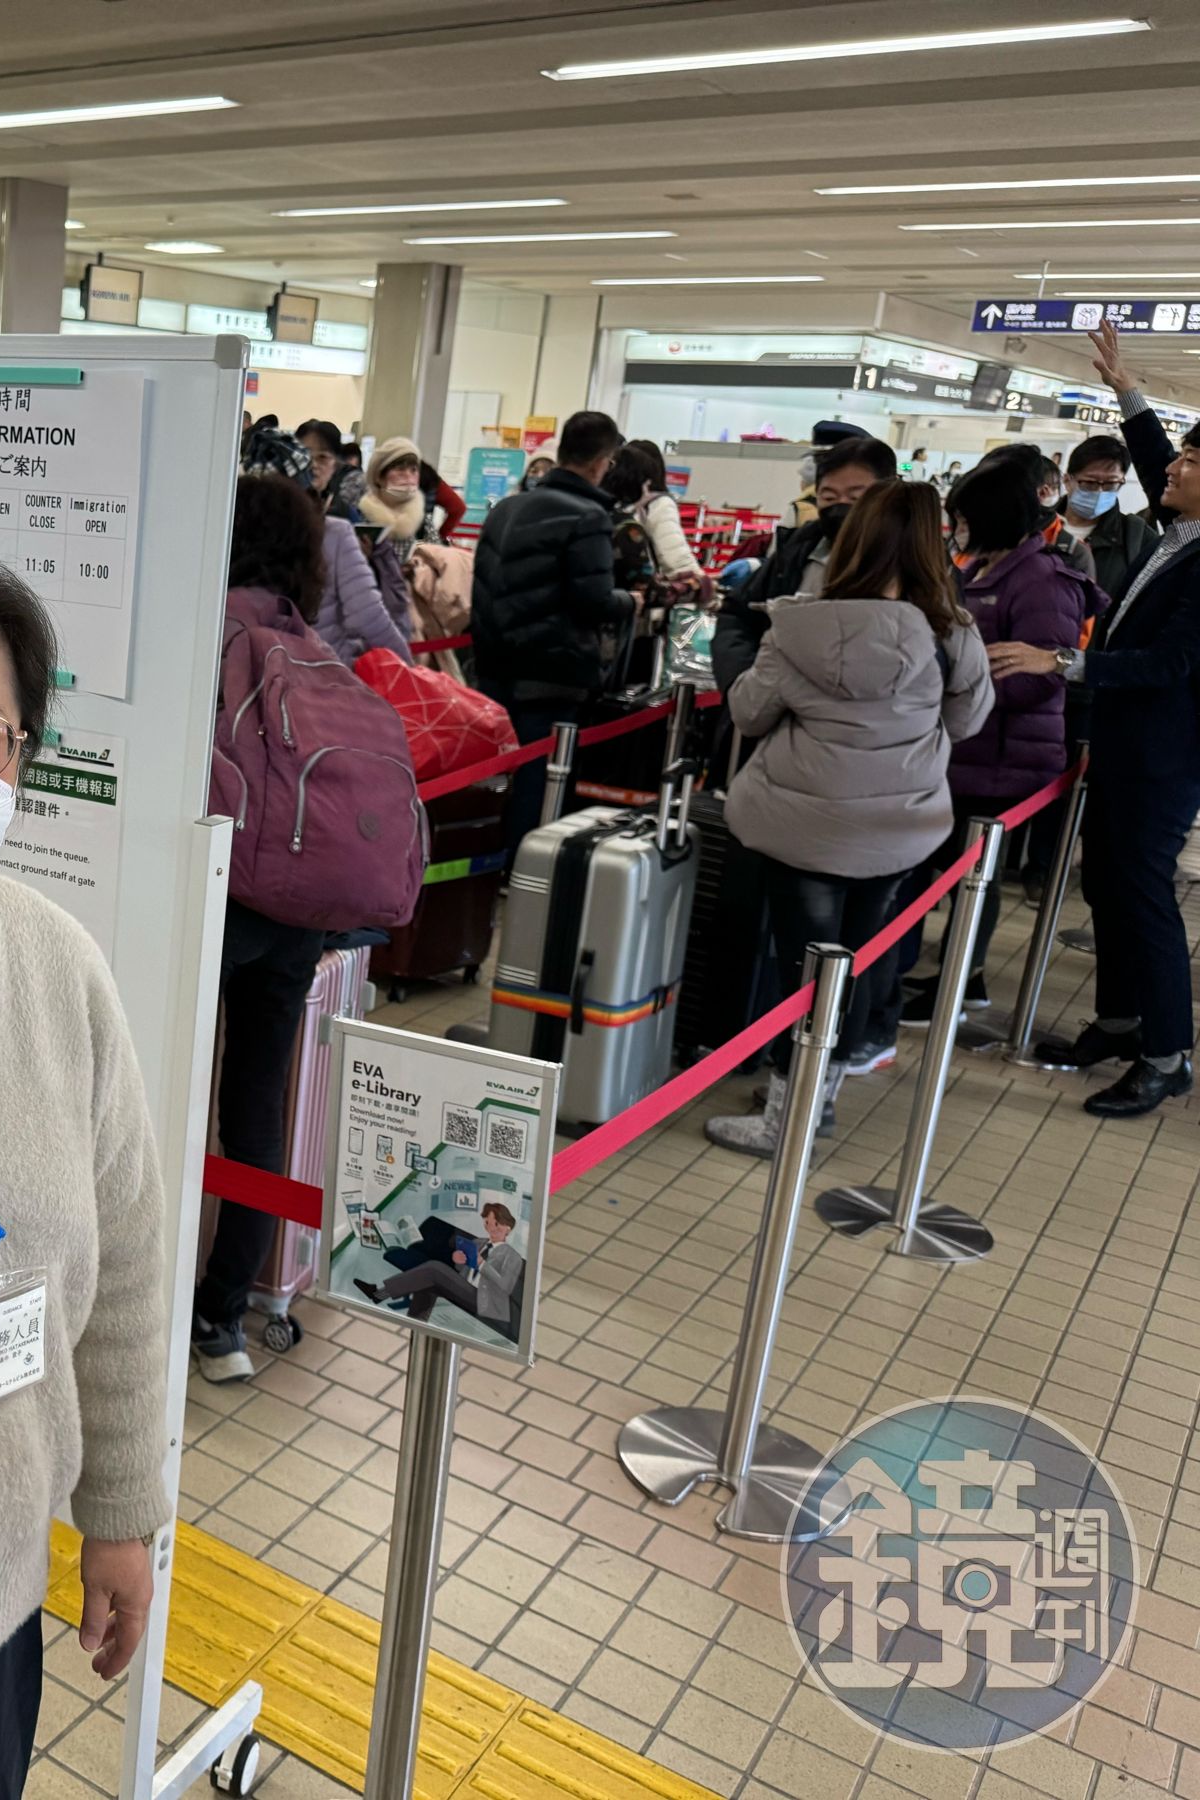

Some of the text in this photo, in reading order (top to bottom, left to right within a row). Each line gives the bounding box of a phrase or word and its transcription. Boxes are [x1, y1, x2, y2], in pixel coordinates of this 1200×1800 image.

[865, 367, 877, 389] 1
[1006, 392, 1021, 410] 2
[25, 494, 62, 509] COUNTER
[29, 514, 56, 529] CLOSE
[85, 520, 107, 533] OPEN
[25, 558, 56, 574] 11:05
[79, 563, 109, 580] 10:00
[60, 746, 97, 760] EVA AIR
[4, 839, 90, 864] need to join the queue.
[20, 863, 48, 876] ground
[49, 869, 69, 880] staff
[68, 874, 76, 883] at
[77, 877, 96, 888] gate
[352, 1060, 384, 1080] EVA
[351, 1078, 422, 1107] e-Library
[486, 1081, 524, 1095] EVA AIR
[349, 1105, 386, 1121] Download
[349, 1113, 368, 1126] Enjoy
[369, 1119, 386, 1128] your
[443, 1182, 473, 1191] NEWS
